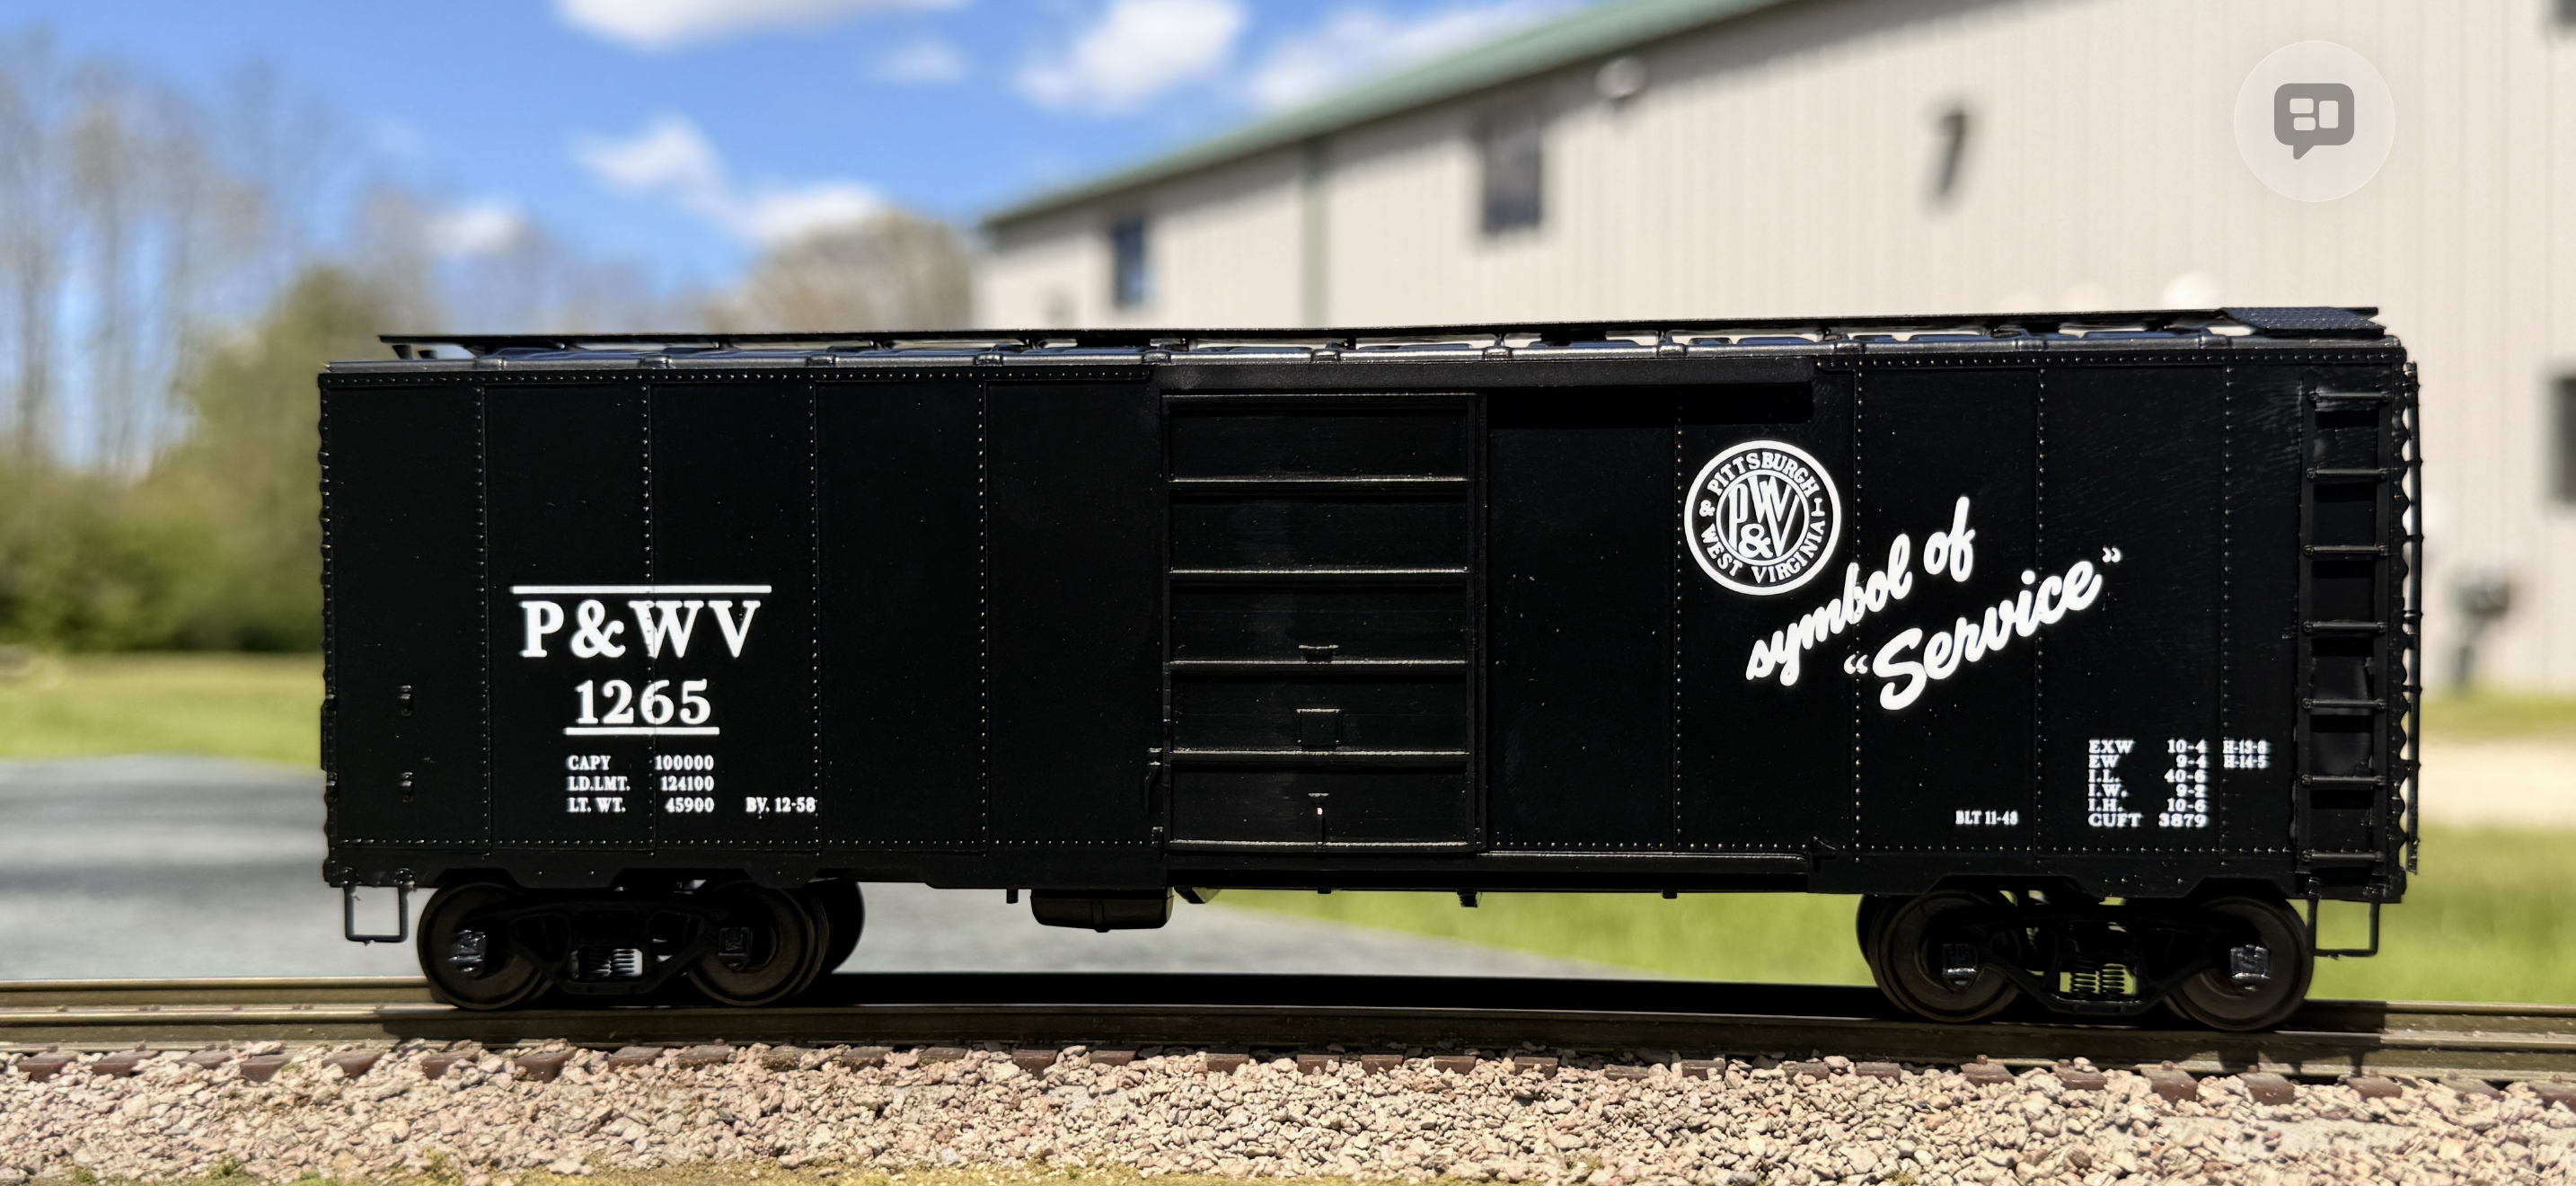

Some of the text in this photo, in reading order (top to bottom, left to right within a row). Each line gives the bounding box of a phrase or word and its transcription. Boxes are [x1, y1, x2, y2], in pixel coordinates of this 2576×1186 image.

[1707, 451, 1821, 498] PITTSBURGH
[1698, 499, 1826, 584] & WEST VIRGINIA
[1745, 495, 1976, 686] symbol of
[519, 598, 762, 659] P&WV
[575, 678, 712, 725] 1265
[2088, 739, 2135, 755] EXW
[2166, 739, 2209, 754] 10-4
[567, 754, 715, 771] CAPY 100000
[2088, 755, 2122, 769] EW
[2175, 754, 2209, 768] 9-4
[660, 775, 715, 792] 124100
[2087, 769, 2207, 783] I.L. 40-6
[2087, 783, 2207, 798] I.W. 9-2
[567, 796, 592, 813] LT.
[595, 796, 627, 813] WT.
[665, 796, 715, 813] 45900
[774, 796, 816, 813] 12-58
[2087, 798, 2207, 812] I.H. 10-6
[1954, 810, 2019, 826] BLT 11-48
[2087, 813, 2208, 828] CUFT 3879
